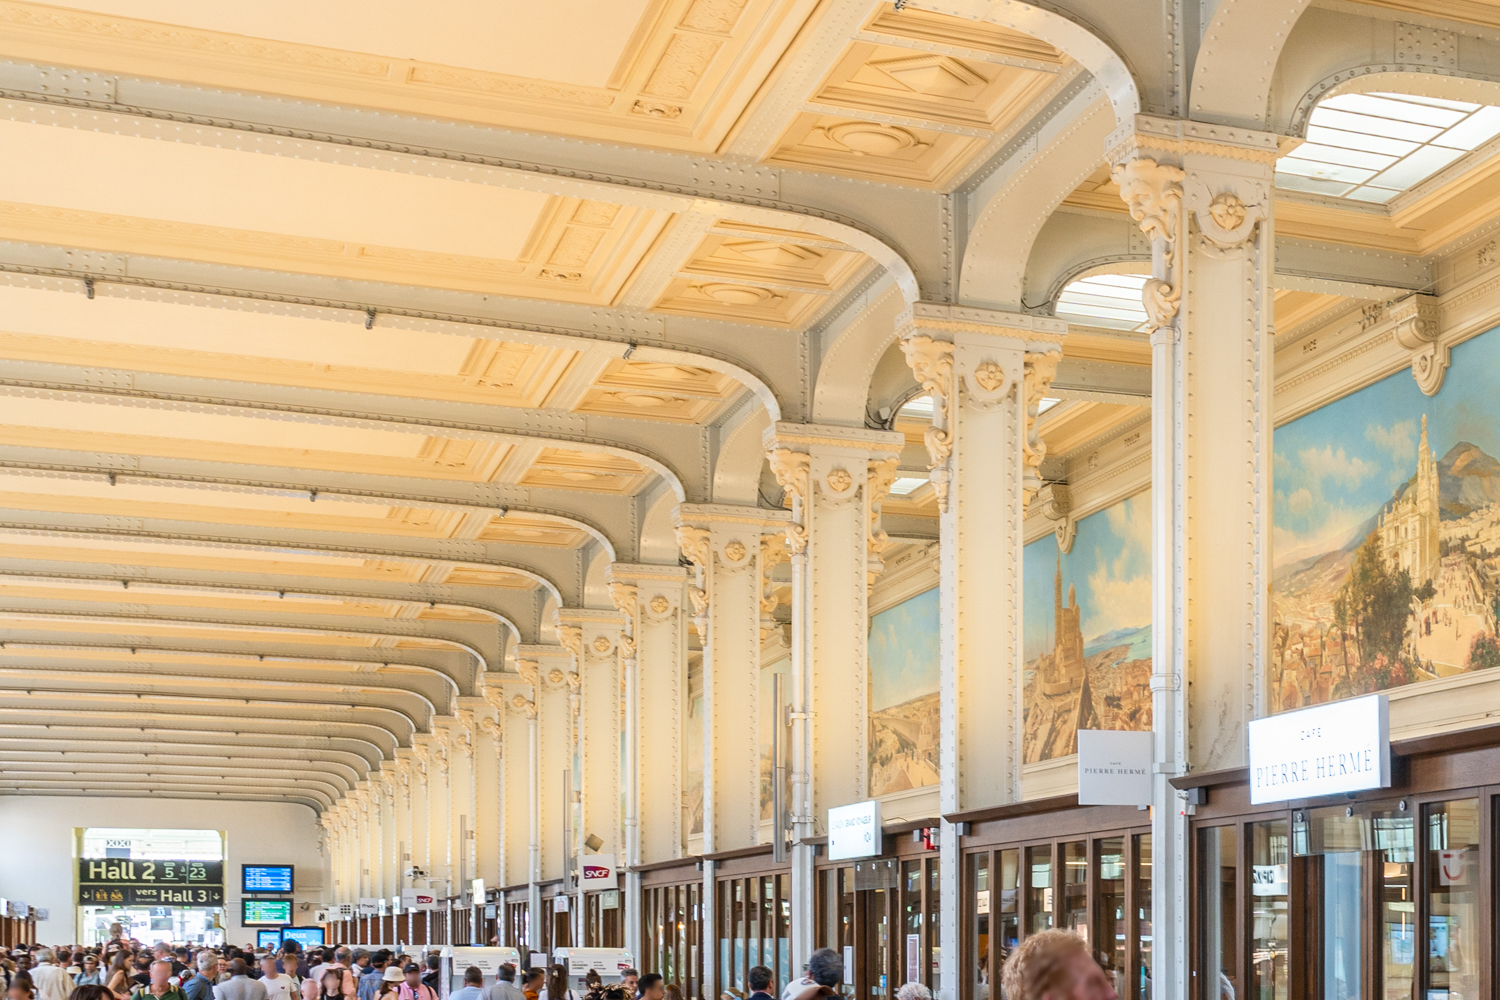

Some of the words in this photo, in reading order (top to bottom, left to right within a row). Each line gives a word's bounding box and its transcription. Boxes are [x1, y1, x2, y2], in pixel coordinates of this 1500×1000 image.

[1084, 767, 1115, 775] PIERRE
[1117, 767, 1146, 775] HERMÉ
[1256, 759, 1309, 788] PIERRE
[1316, 743, 1373, 779] HERMÉ
[89, 861, 136, 880] Hall
[142, 862, 156, 880] 2
[165, 867, 174, 878] 5
[189, 867, 207, 878] 23
[585, 869, 609, 880] SNCF
[160, 889, 194, 902] Hall
[197, 890, 207, 902] 3
